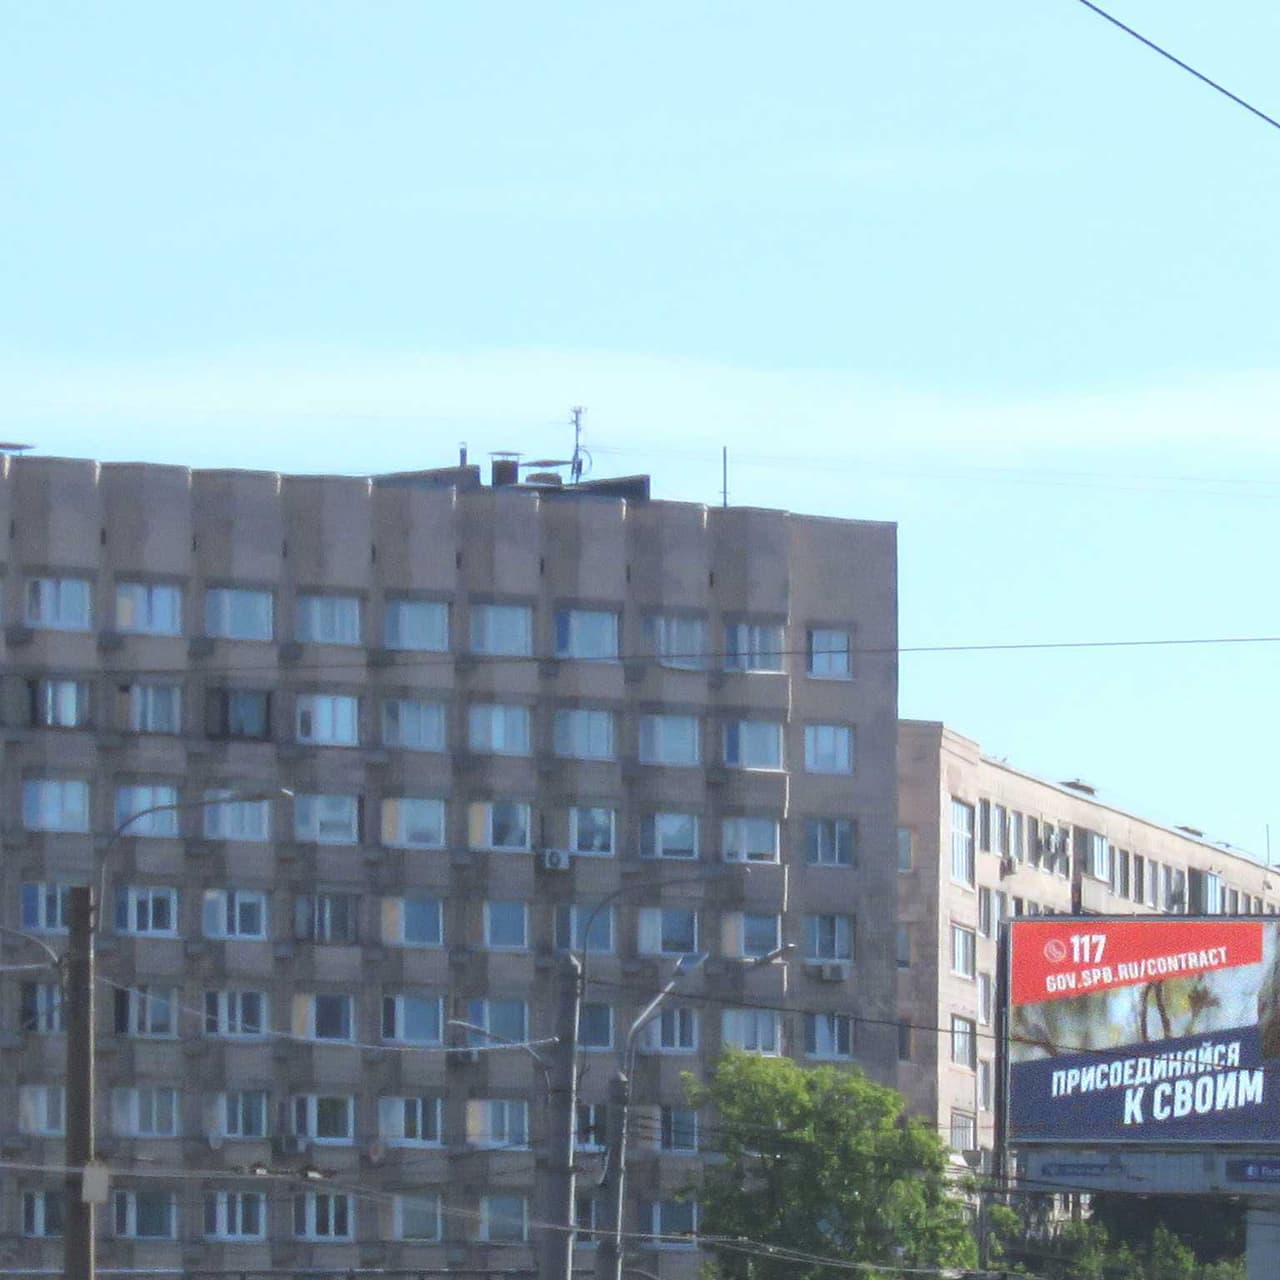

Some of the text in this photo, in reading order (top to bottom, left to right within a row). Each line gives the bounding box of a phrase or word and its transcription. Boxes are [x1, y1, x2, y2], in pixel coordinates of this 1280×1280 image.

[1045, 946, 1228, 993] GOV.SPB.RU/CONTRACT
[1070, 934, 1106, 964] 117
[1052, 1041, 1241, 1098] ПРИСОЕДИНЯЙСЯ
[1123, 1067, 1265, 1125] К СВОИМ
